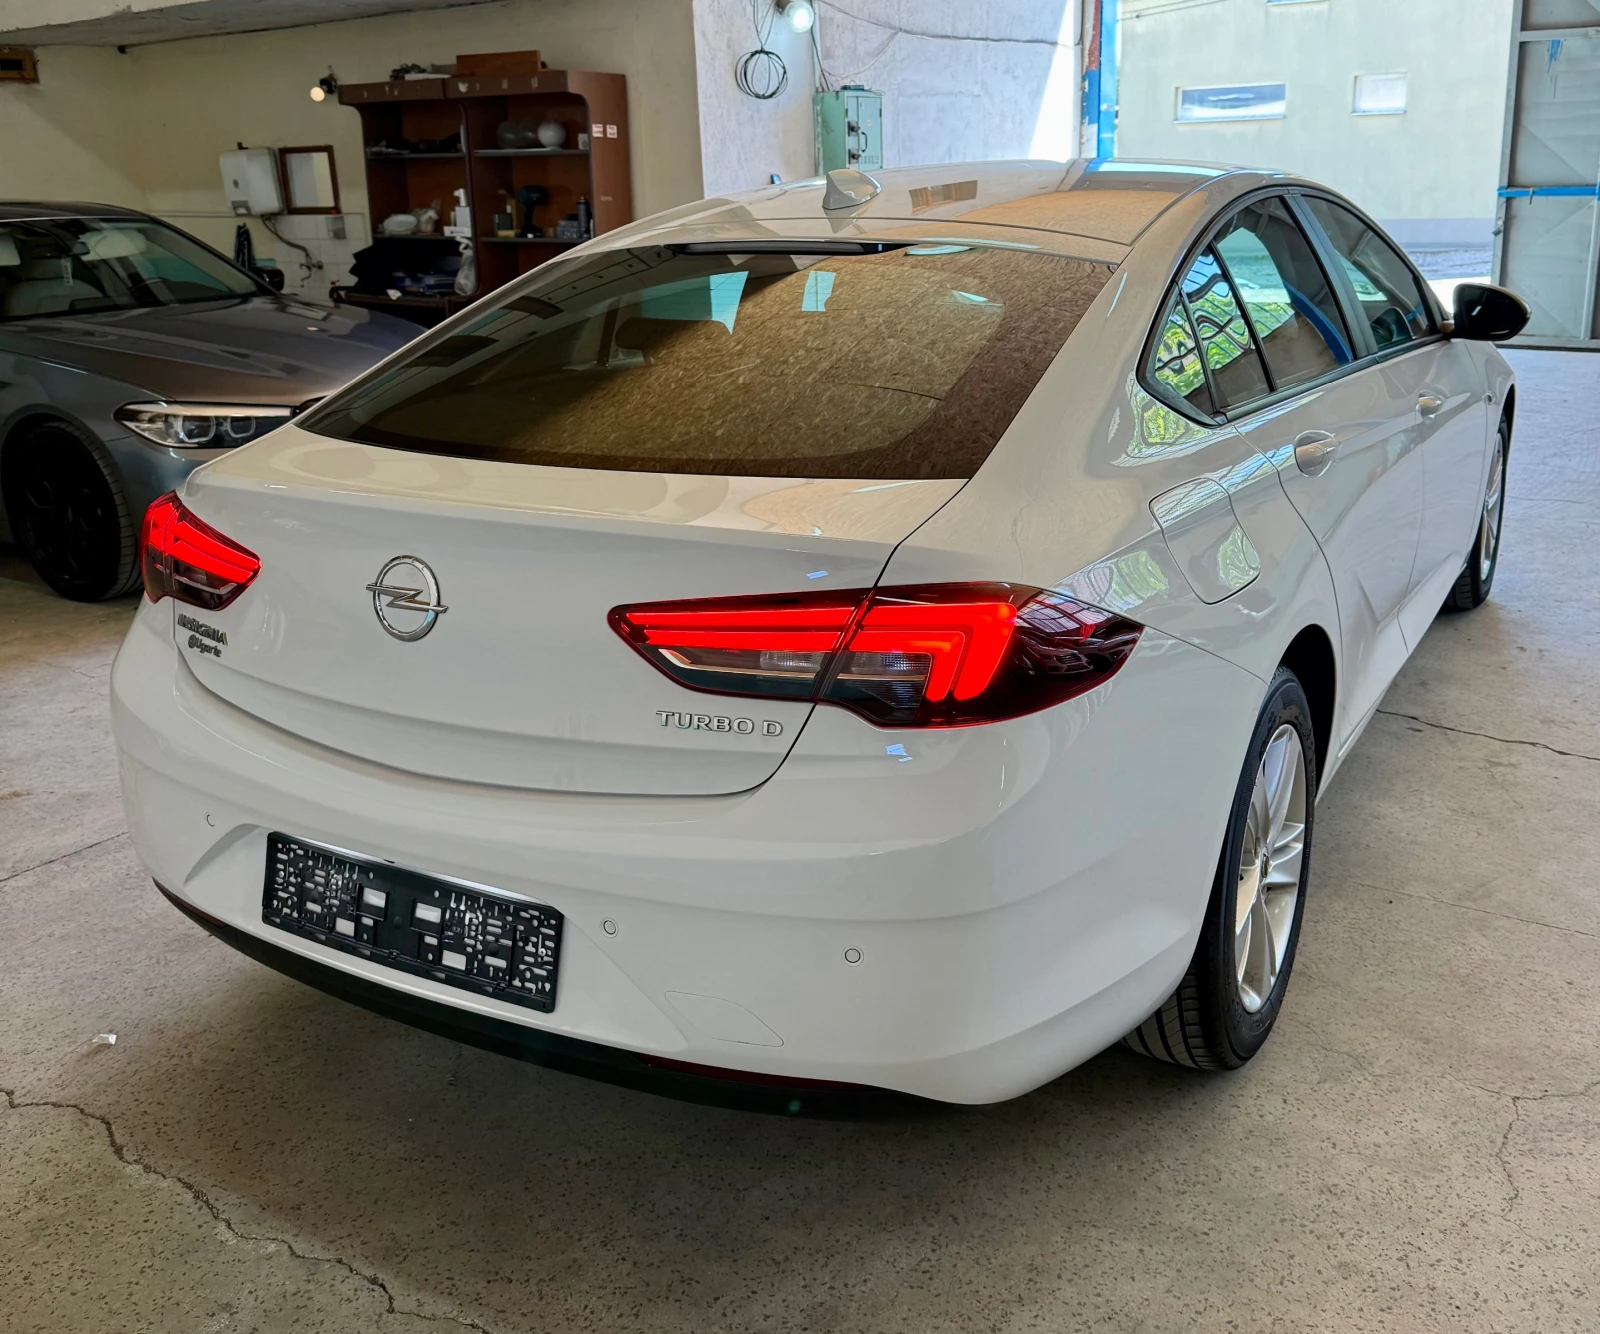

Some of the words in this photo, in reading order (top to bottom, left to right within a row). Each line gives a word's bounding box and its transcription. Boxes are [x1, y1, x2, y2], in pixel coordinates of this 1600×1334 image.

[177, 613, 228, 647] INSIGNIA
[655, 710, 755, 735] TURBO
[762, 719, 783, 737] D
